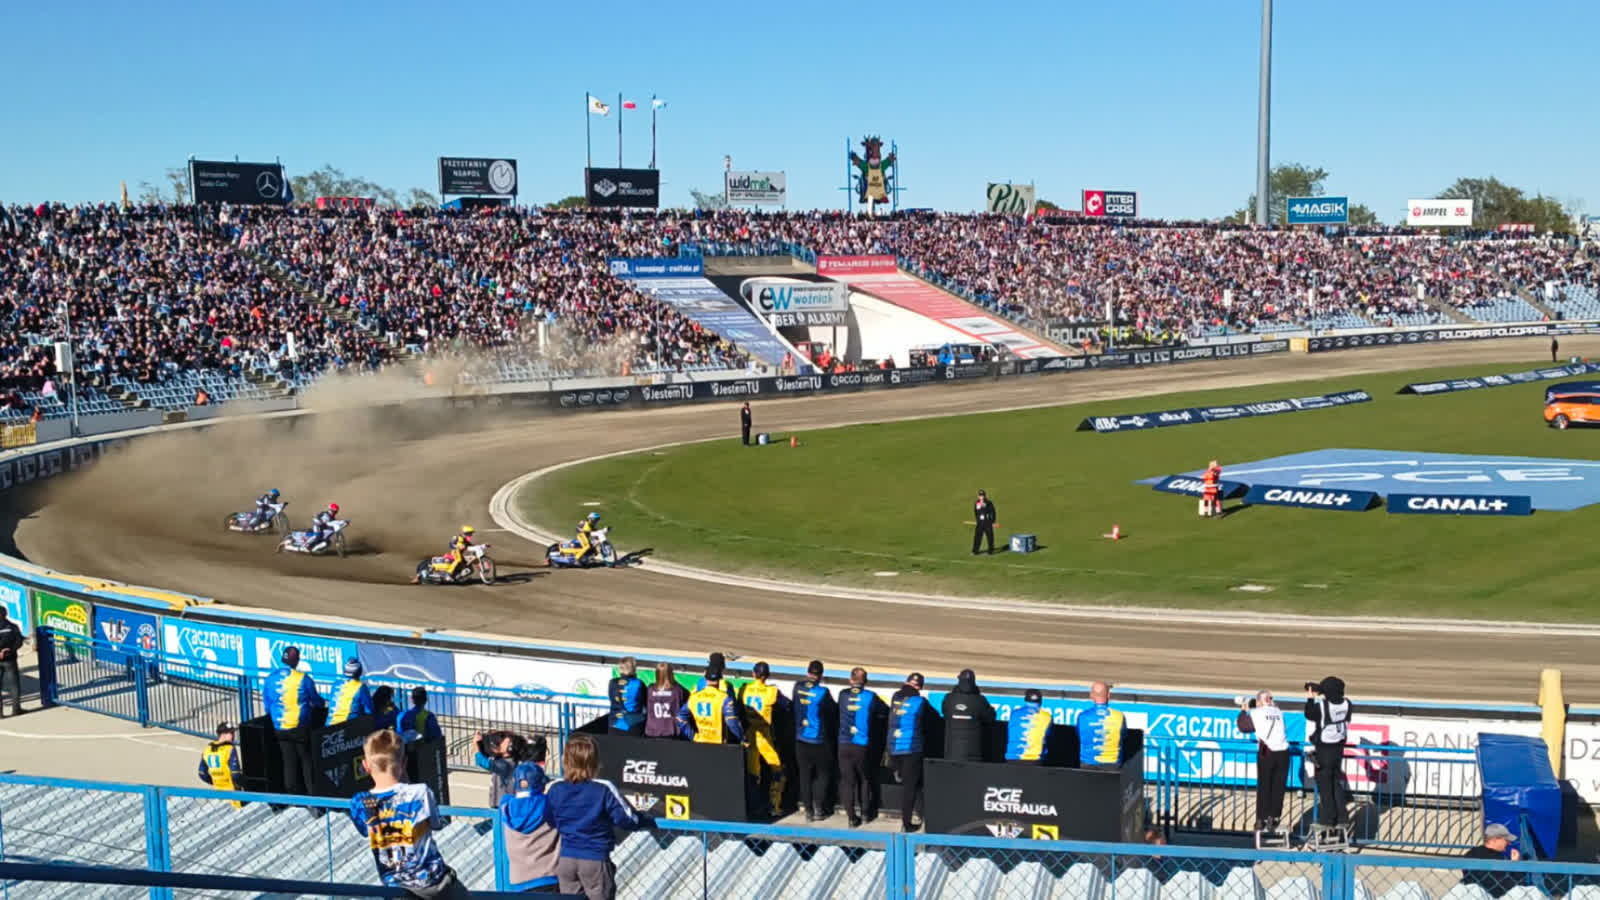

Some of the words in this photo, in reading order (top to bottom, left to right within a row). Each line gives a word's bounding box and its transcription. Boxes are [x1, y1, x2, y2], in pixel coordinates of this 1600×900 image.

[1106, 195, 1134, 204] INTER
[1106, 204, 1134, 213] CARS
[1297, 202, 1345, 214] MAGIK
[808, 312, 846, 325] ALARMY
[1440, 328, 1491, 339] POLCOPPER
[1492, 326, 1547, 336] POLCOPPER
[1264, 489, 1352, 507] CANAL+
[1408, 496, 1508, 511] CANAL+
[654, 703, 672, 718] 02
[623, 759, 658, 775] PGE
[623, 773, 689, 788] EKSTRALIGA
[983, 787, 1024, 802] PGE
[983, 801, 1058, 816] EKSTRALIGA
